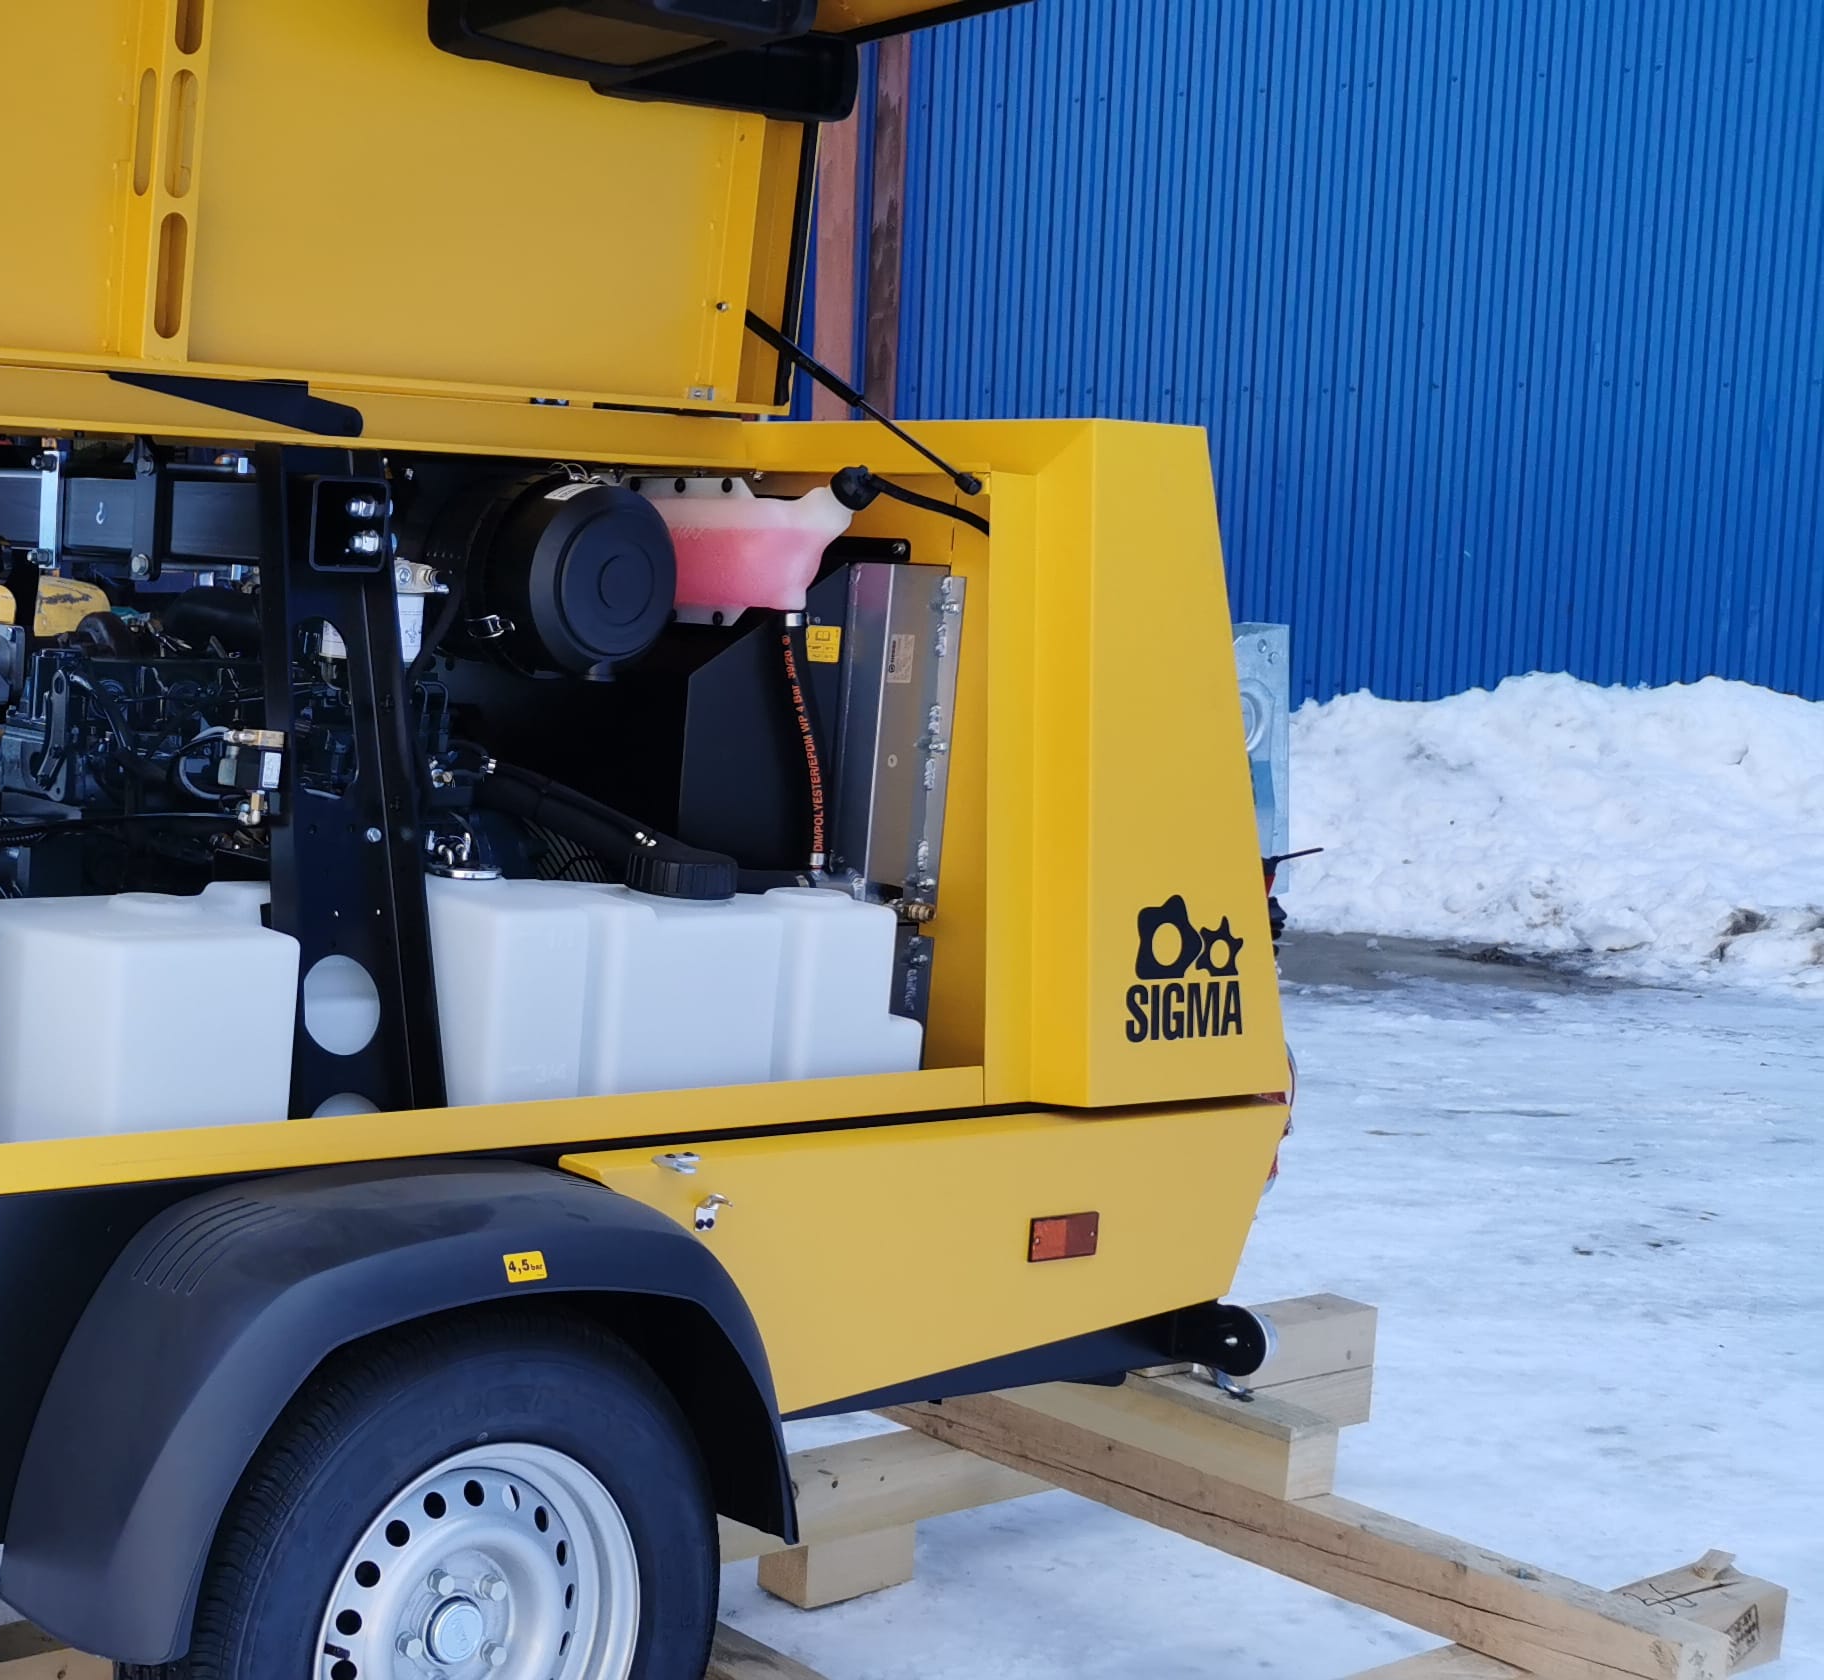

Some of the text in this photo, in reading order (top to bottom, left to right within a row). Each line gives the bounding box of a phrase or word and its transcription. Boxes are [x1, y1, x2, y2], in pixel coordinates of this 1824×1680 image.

[792, 686, 803, 703] Bar
[798, 715, 812, 733] WP
[1126, 981, 1243, 1043] SIGMA
